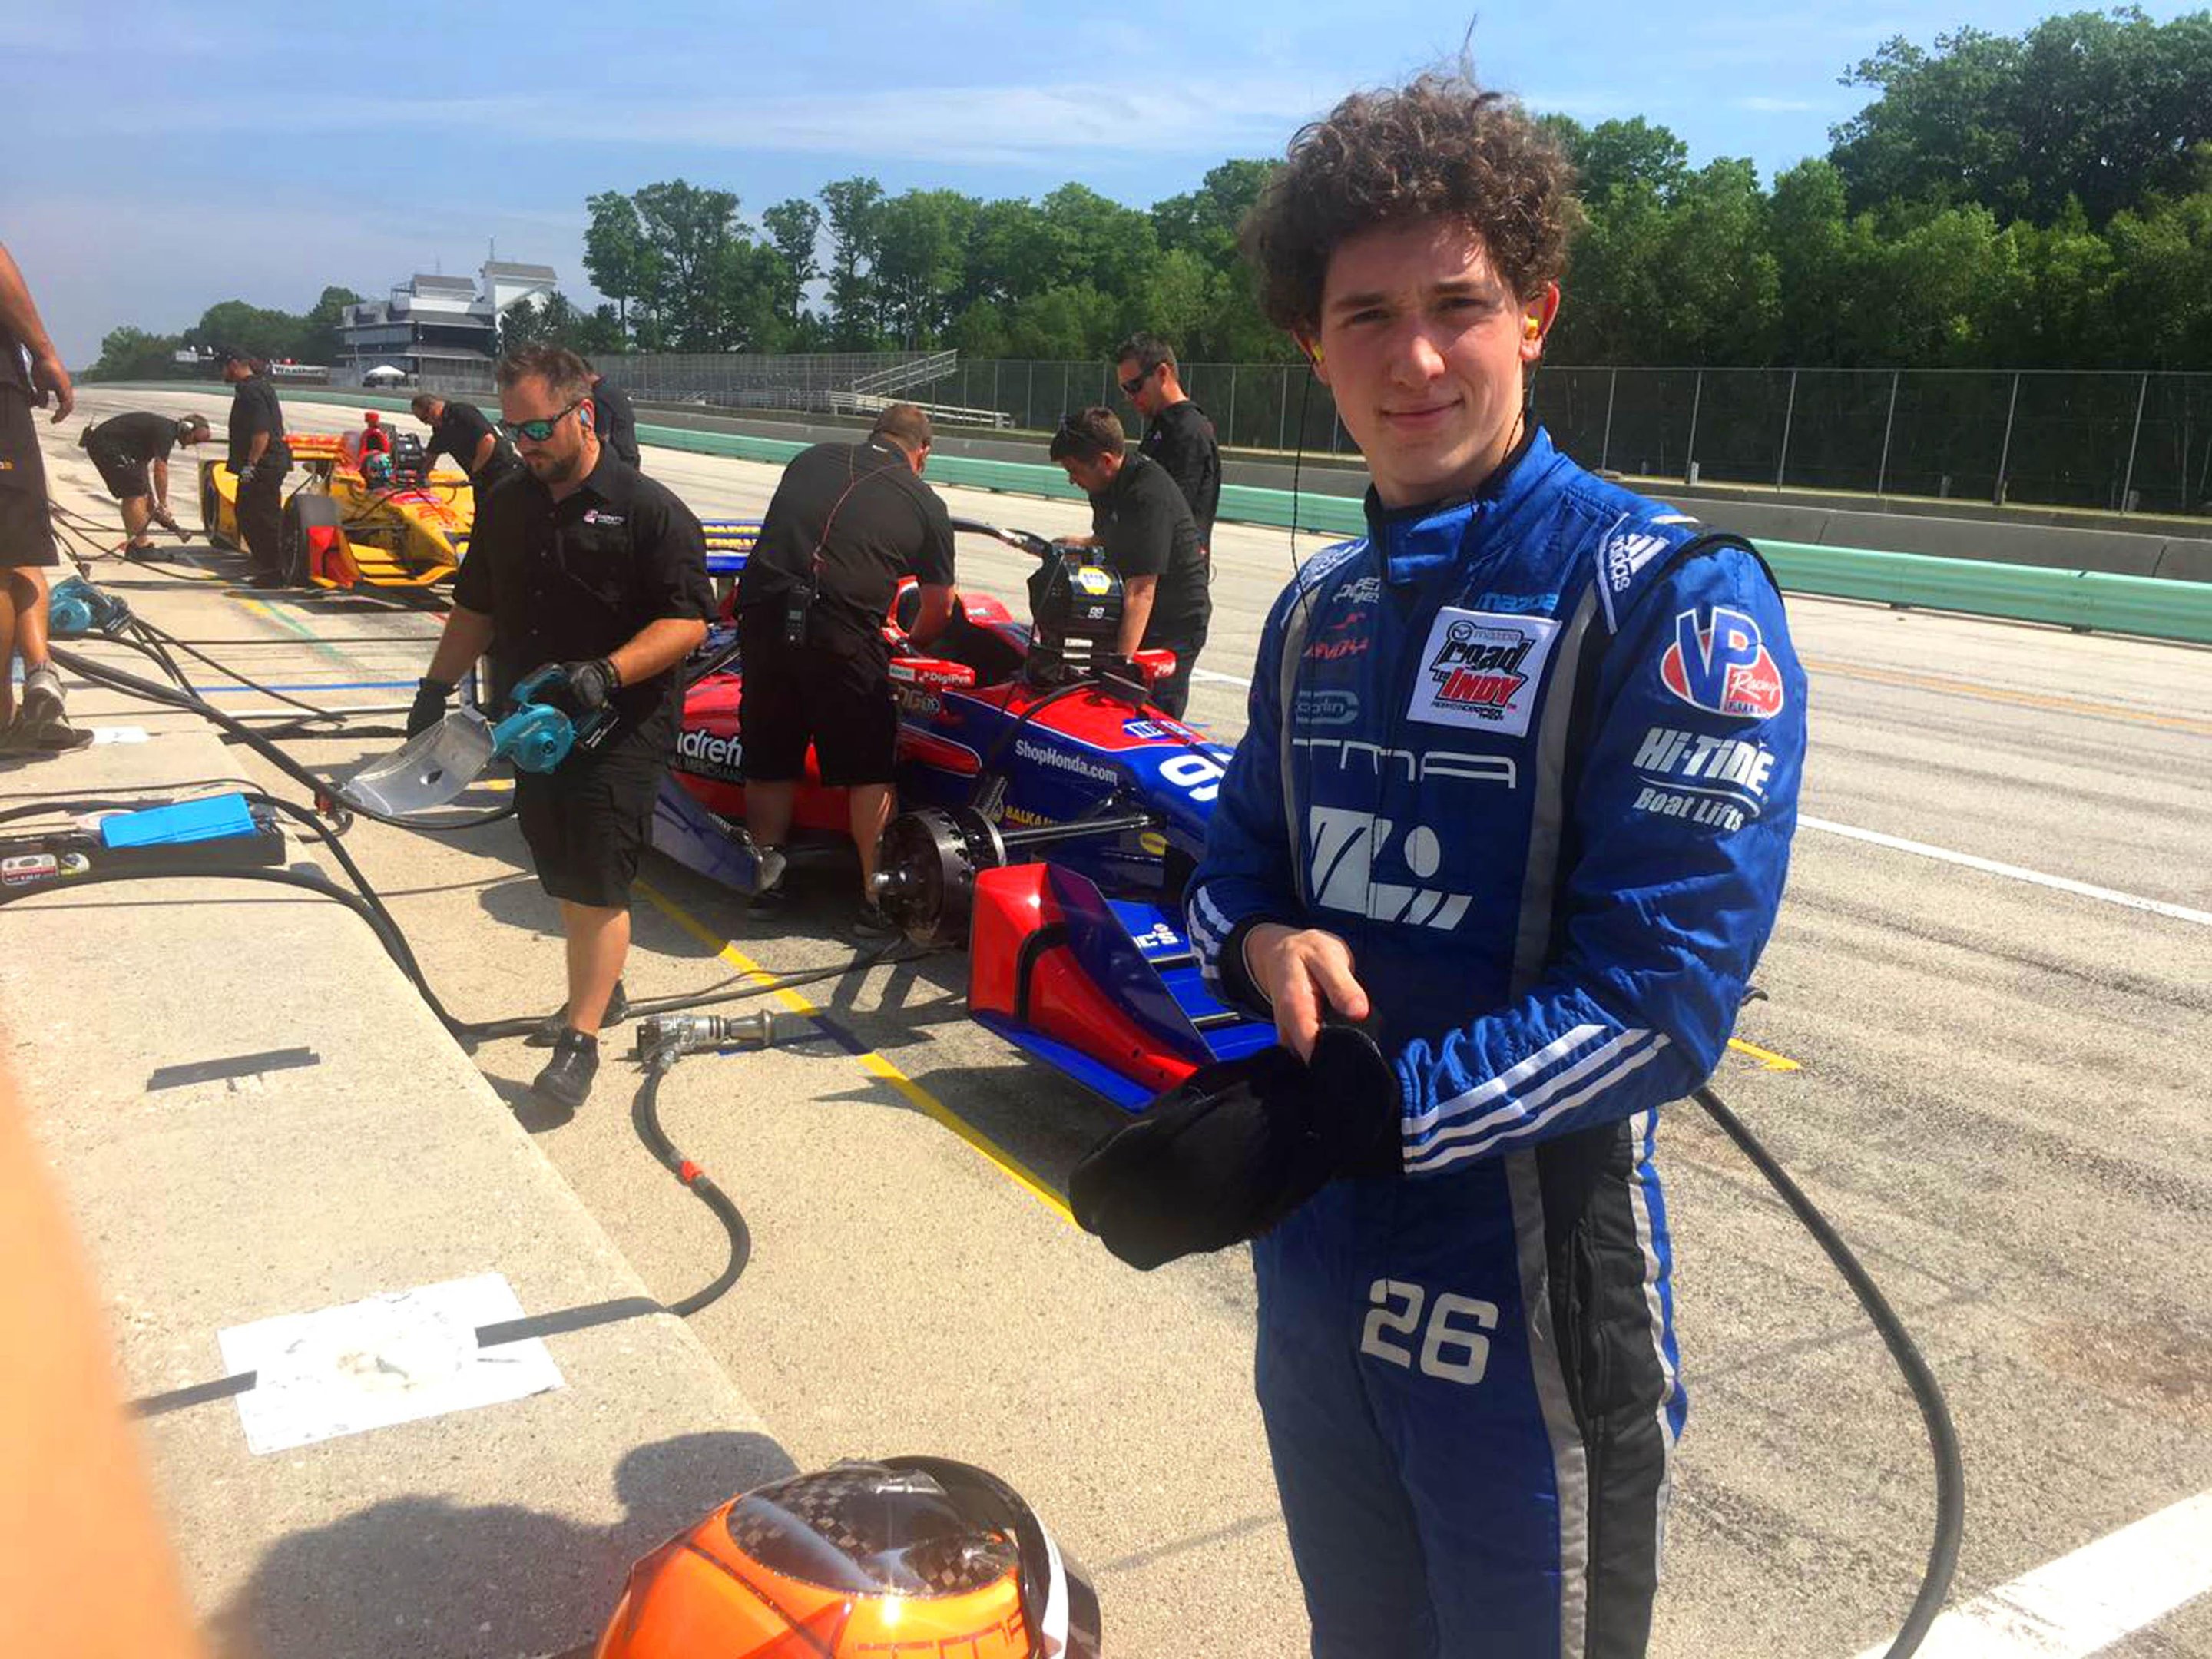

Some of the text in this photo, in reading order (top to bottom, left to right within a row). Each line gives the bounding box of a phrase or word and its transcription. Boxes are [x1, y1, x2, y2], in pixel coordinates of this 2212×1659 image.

[1088, 607, 1105, 619] 98
[930, 673, 972, 686] DigiPen
[1676, 606, 1761, 714] VP
[1015, 739, 1118, 786] ShopHonda.com
[1158, 753, 1233, 801] 9
[1632, 787, 1745, 833] Boat Lifts
[1359, 1277, 1498, 1385] 26
